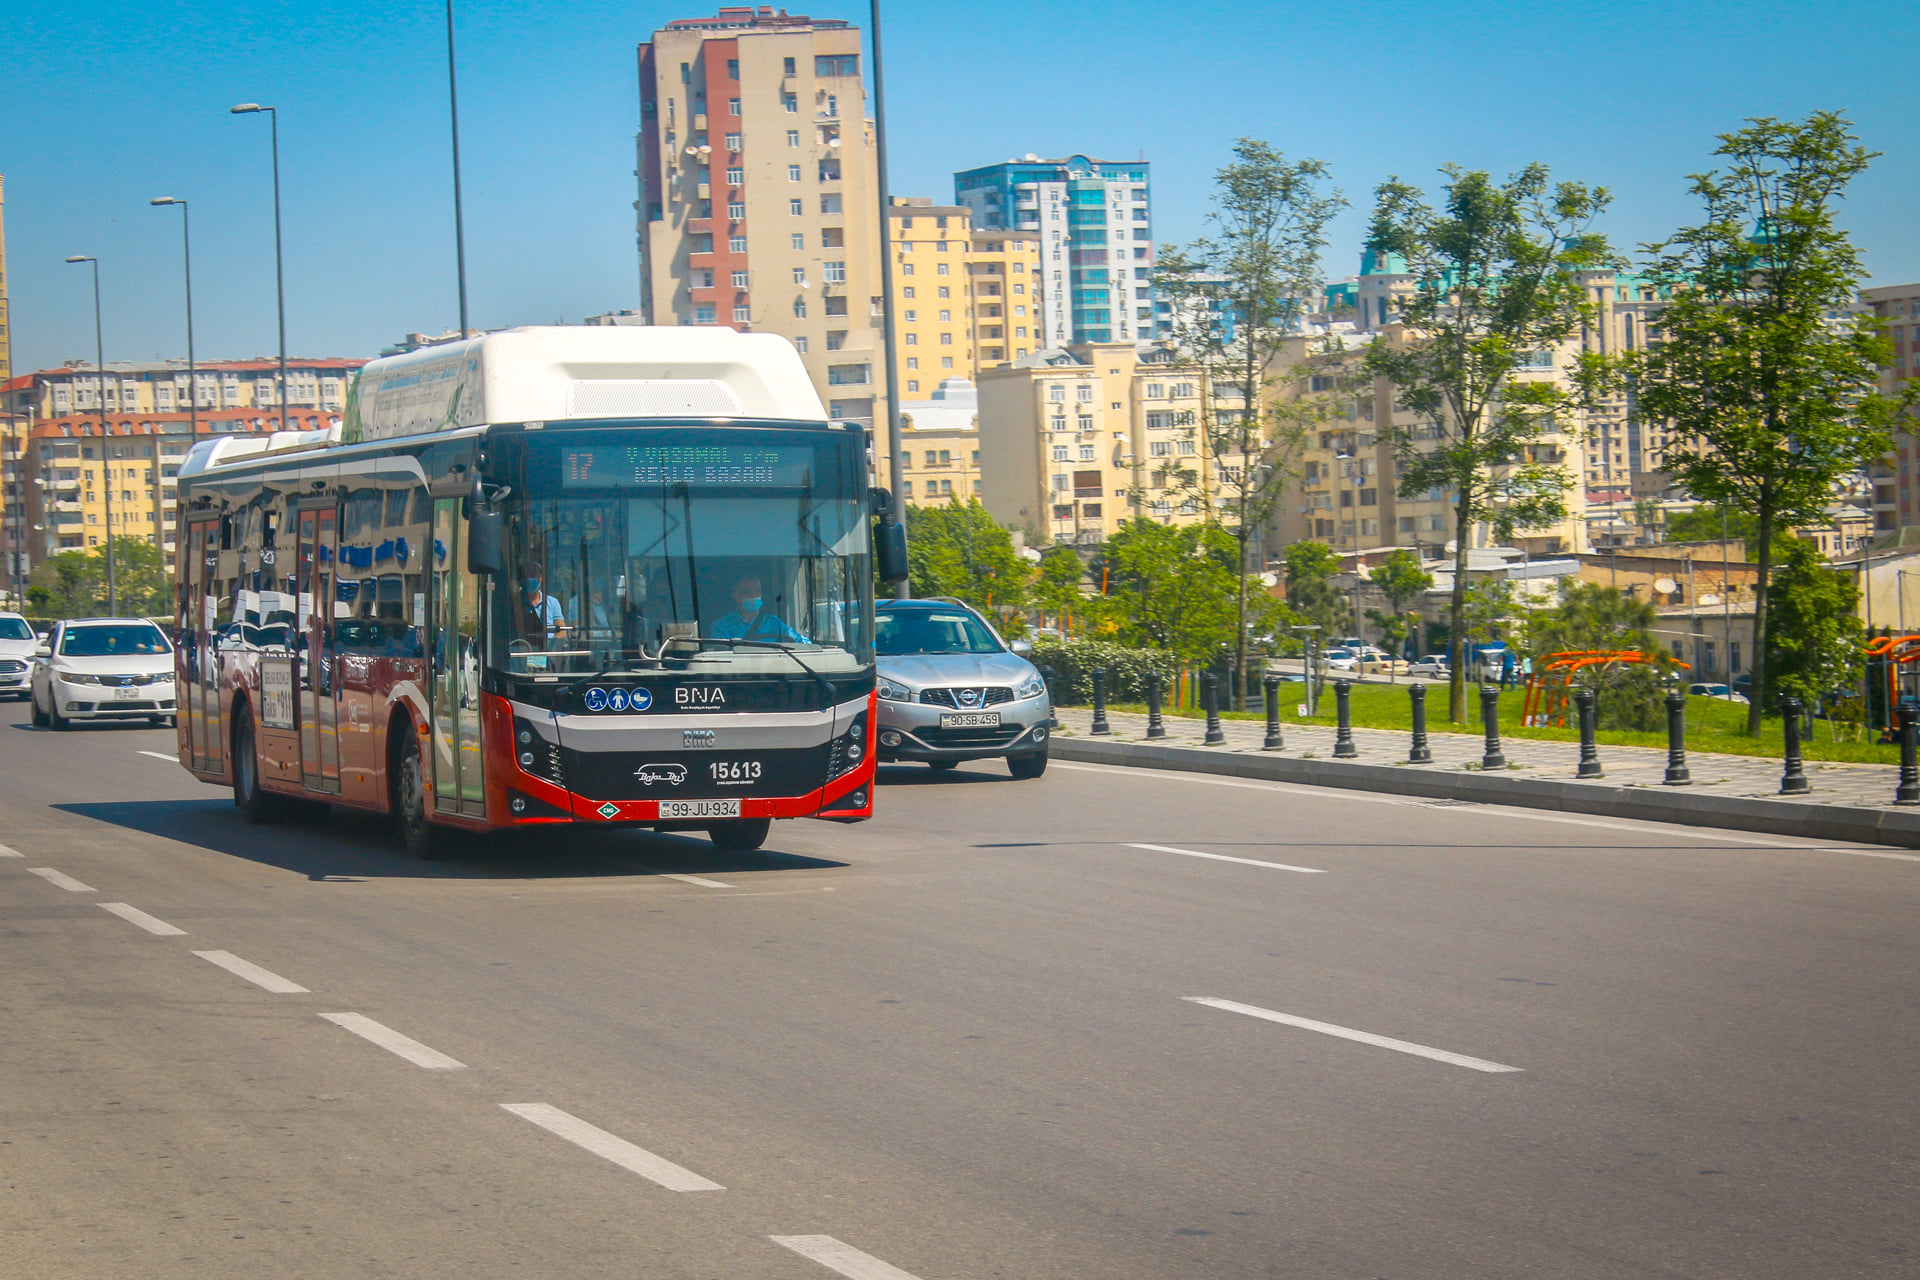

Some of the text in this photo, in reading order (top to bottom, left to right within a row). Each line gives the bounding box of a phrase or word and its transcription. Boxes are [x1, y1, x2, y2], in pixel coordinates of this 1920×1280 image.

[568, 453, 593, 480] 17
[705, 466, 773, 482] BAZARI
[675, 687, 726, 704] BNA
[950, 714, 997, 726] 90-SB-459
[709, 761, 762, 779] 15613
[671, 801, 738, 817] 99-JU-934
